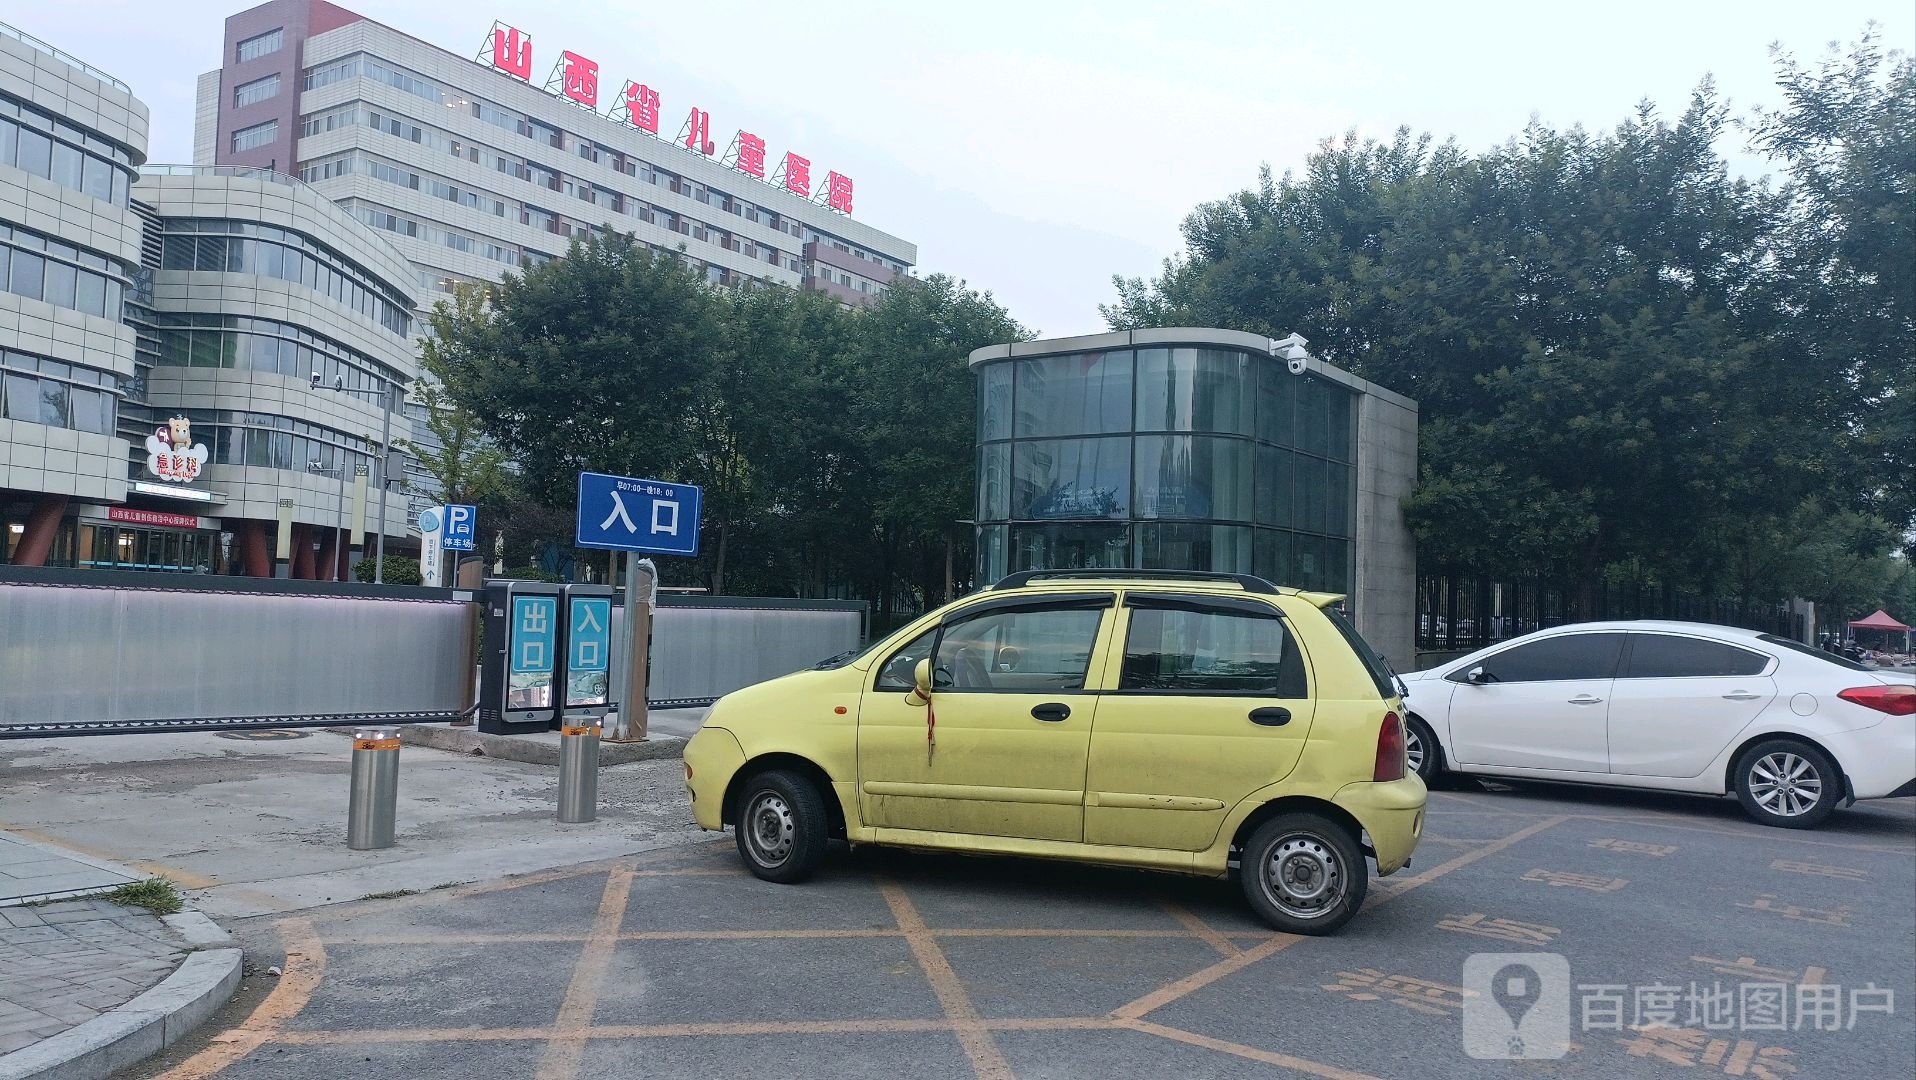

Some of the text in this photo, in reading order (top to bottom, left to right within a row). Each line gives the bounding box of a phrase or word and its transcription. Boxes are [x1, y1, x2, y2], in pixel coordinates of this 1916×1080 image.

[494, 27, 853, 214] 山西省儿童医院
[449, 507, 469, 535] P
[600, 490, 680, 536] 入口
[444, 537, 471, 548] 停车场
[522, 603, 547, 668] 出口
[577, 604, 602, 667] 入口
